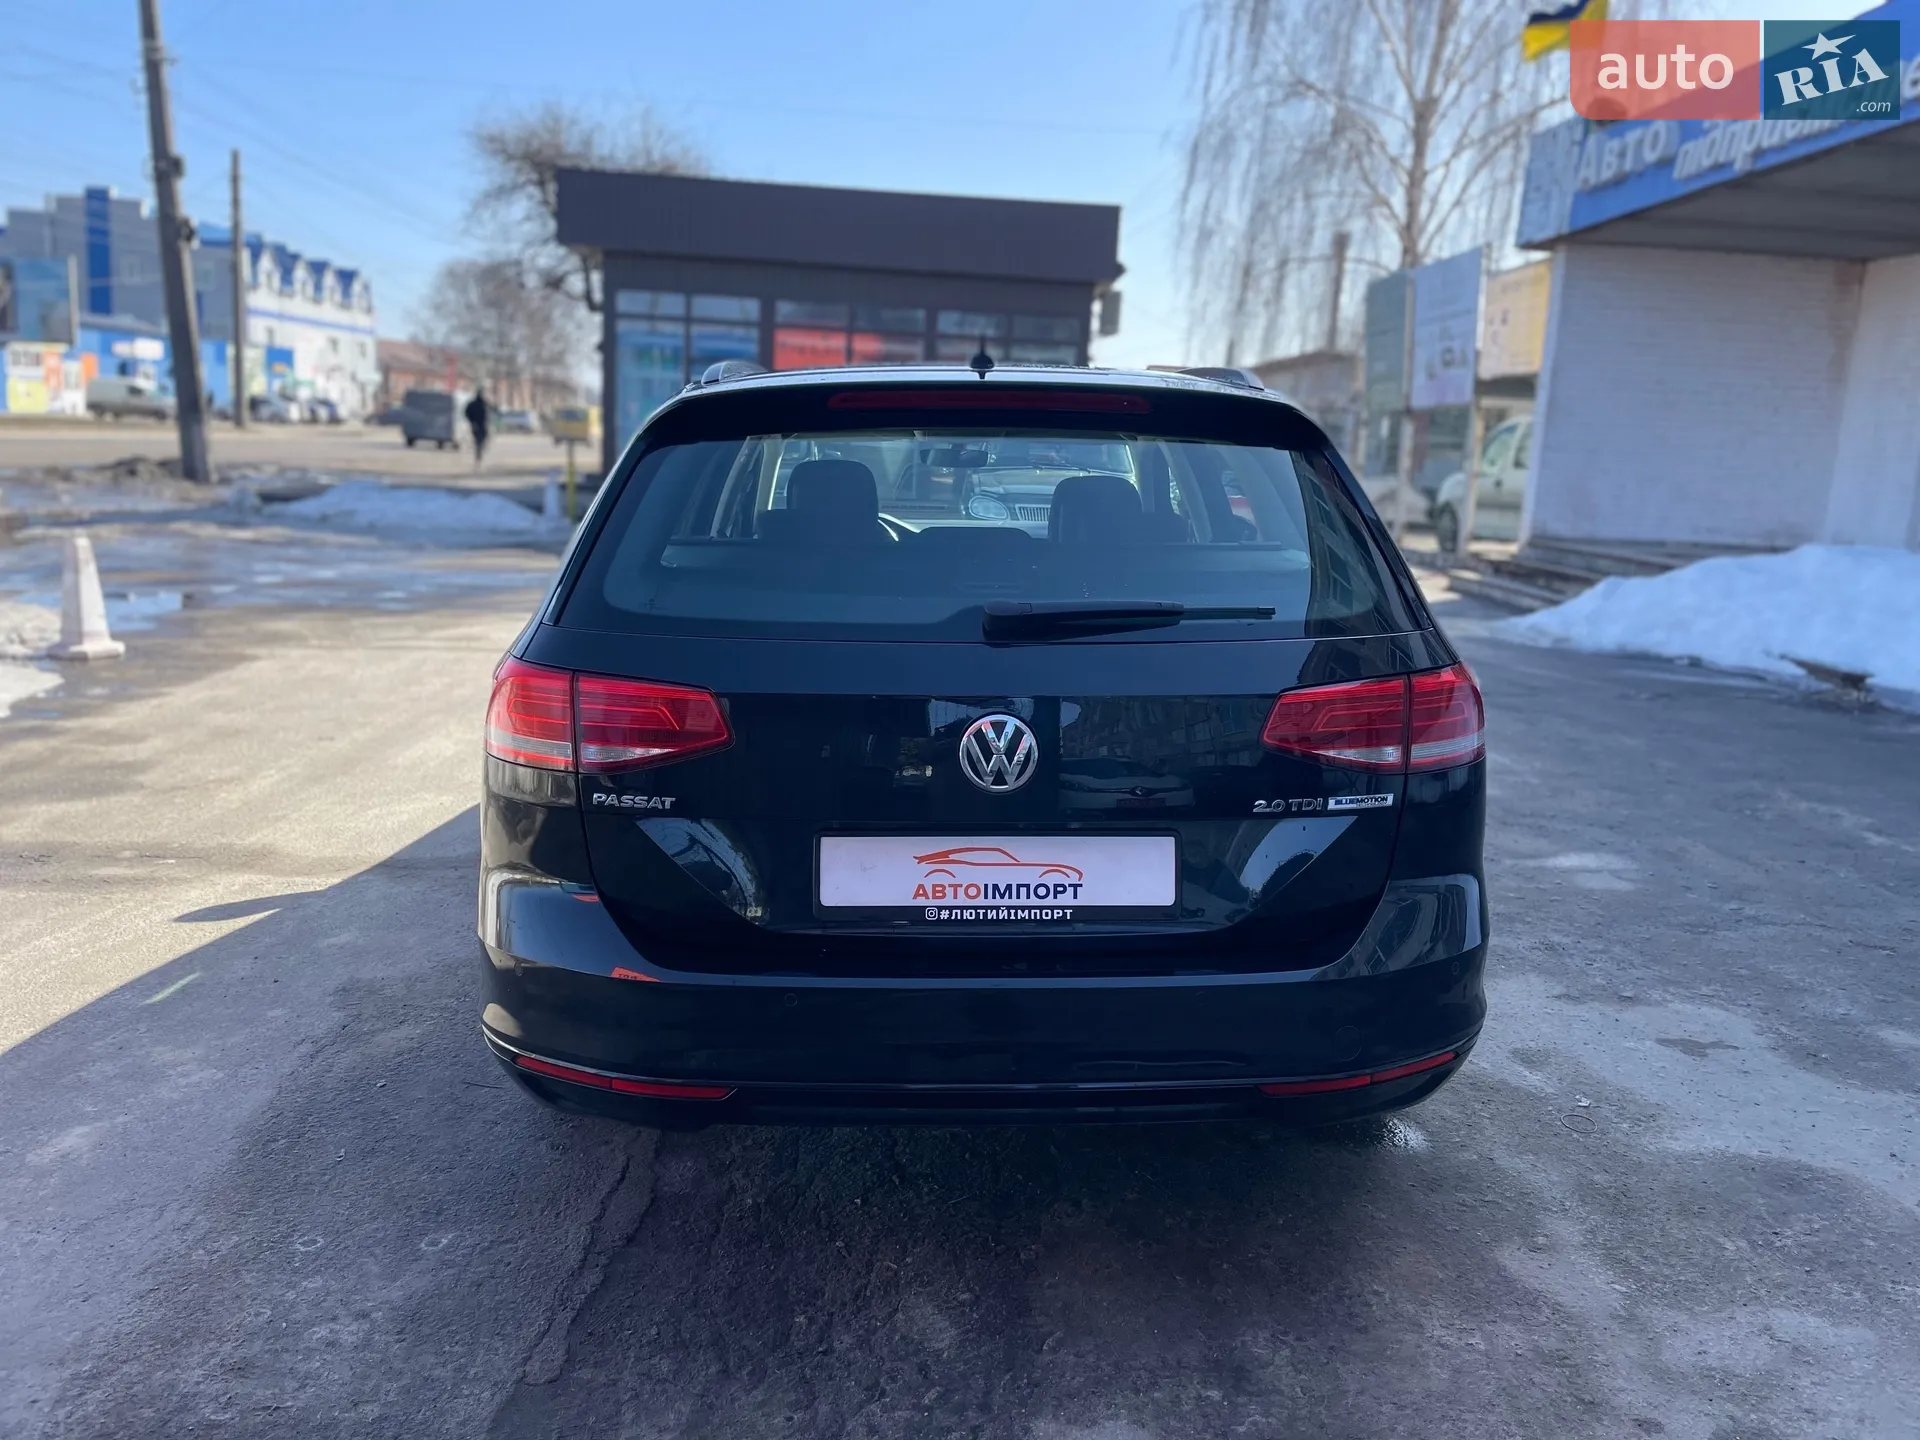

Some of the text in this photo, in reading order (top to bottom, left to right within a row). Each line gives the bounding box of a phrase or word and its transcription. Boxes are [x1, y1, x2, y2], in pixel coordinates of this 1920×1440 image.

[592, 793, 676, 809] PASSAT
[1253, 798, 1323, 812] 2.0 TDI
[912, 883, 1083, 900] АВТОІМПОРТ
[939, 907, 1073, 920] #ЛЮТИЙІМПОРТ
